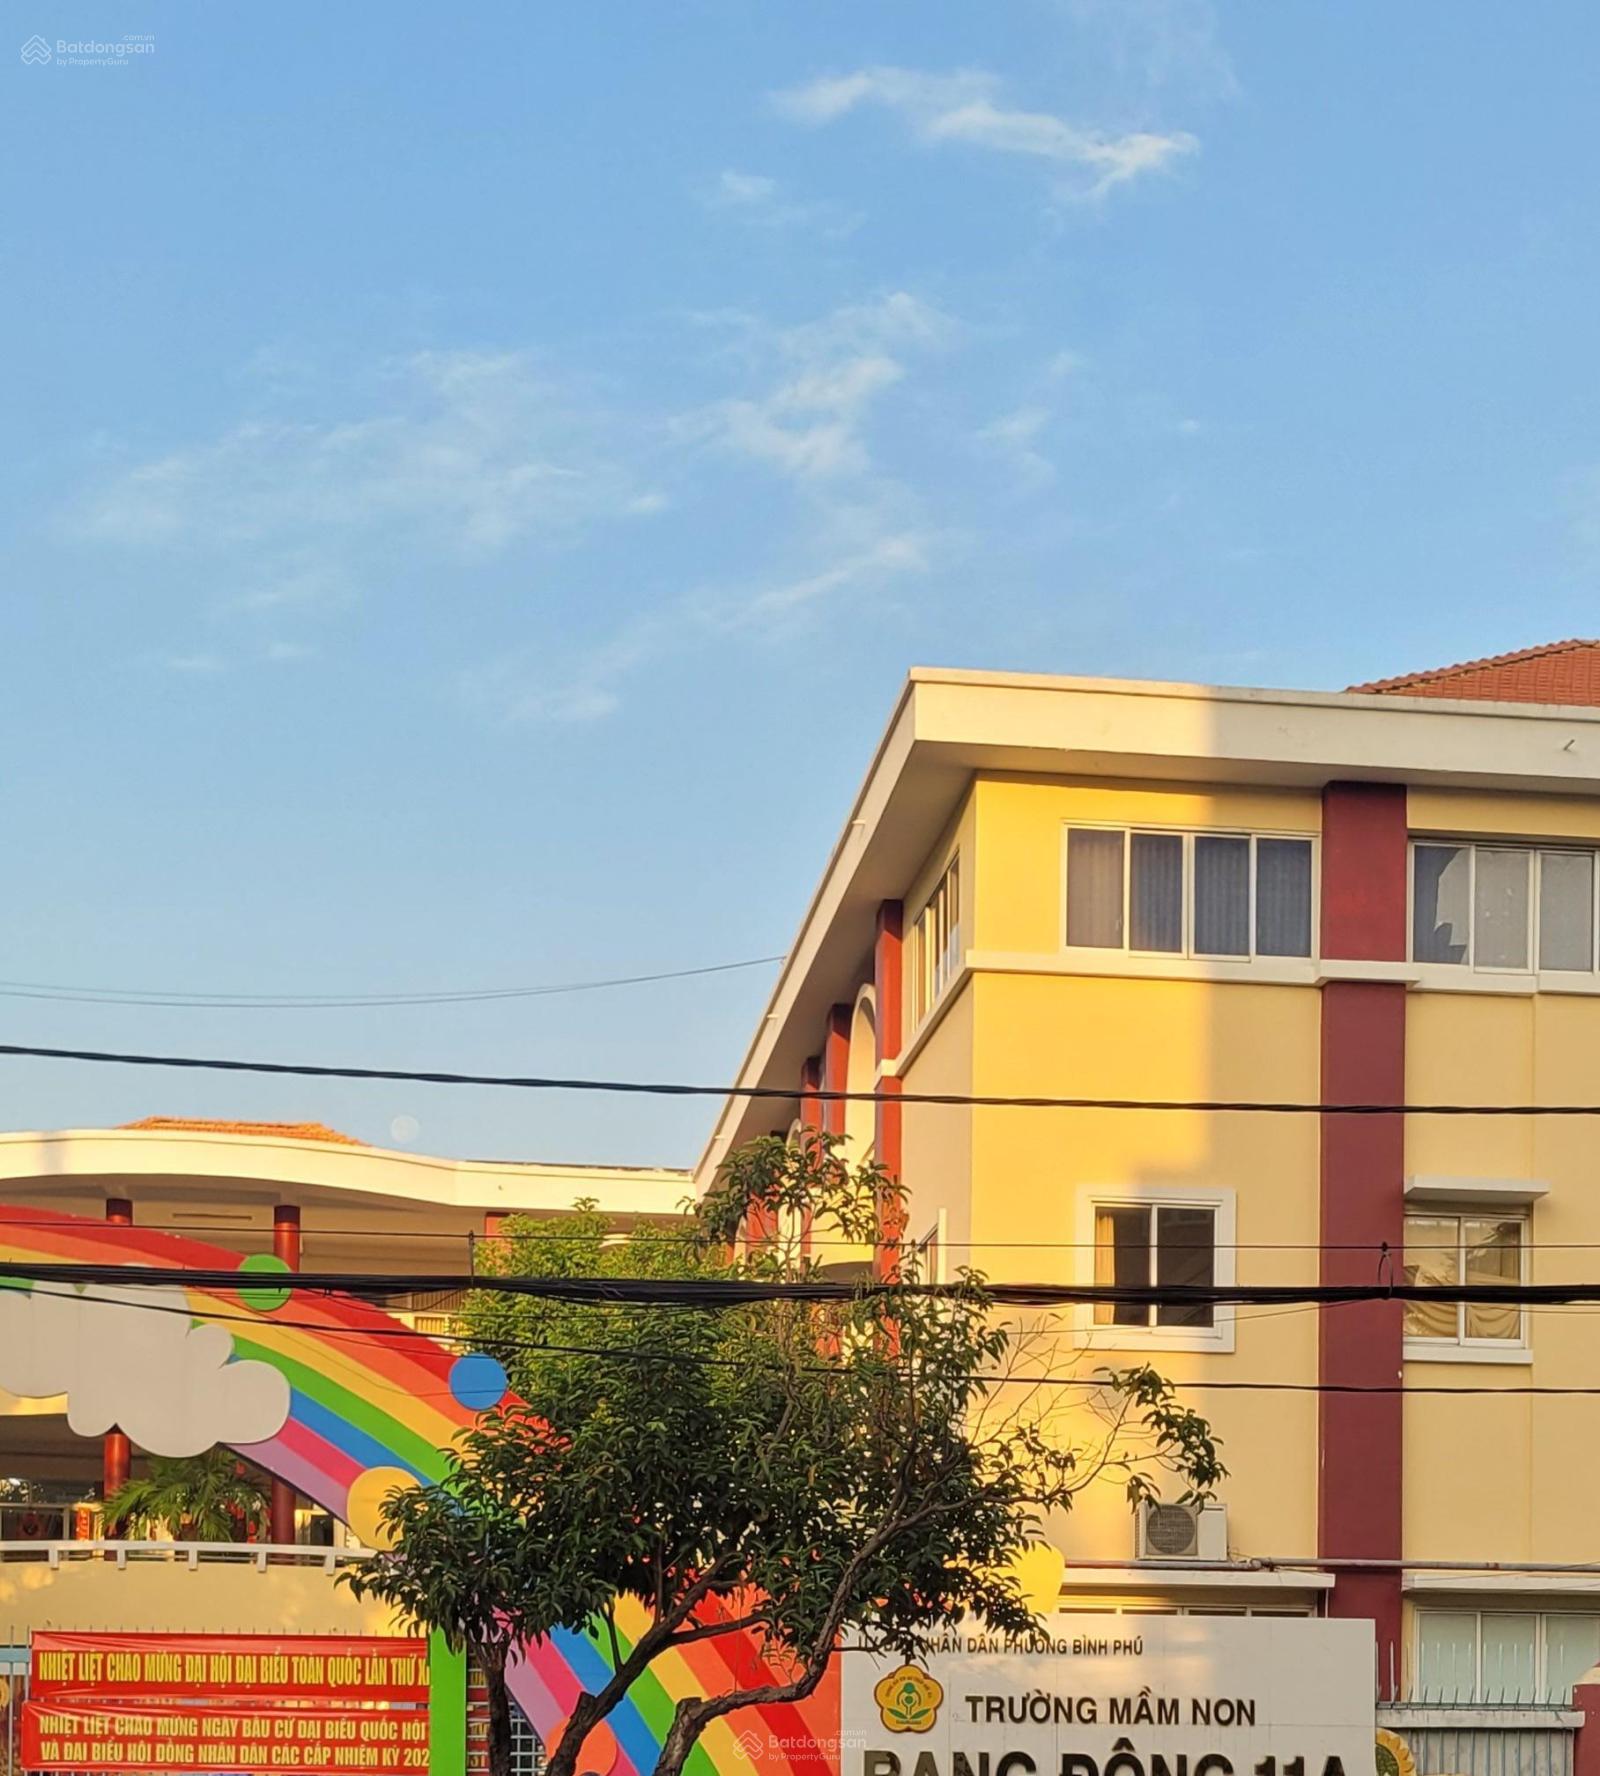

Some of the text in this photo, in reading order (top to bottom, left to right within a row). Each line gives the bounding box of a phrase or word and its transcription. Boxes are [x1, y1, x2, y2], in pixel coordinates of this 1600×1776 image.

[968, 1634, 998, 1655] DÂN
[1073, 1635, 1109, 1656] BÌNH
[1113, 1635, 1144, 1656] PHÚ
[39, 1649, 75, 1687] NHIỆT
[78, 1649, 104, 1687] LIỆT
[107, 1649, 141, 1682] CHÀO
[144, 1650, 182, 1683] MỪNG
[185, 1652, 207, 1689] ĐẠI
[210, 1650, 232, 1689] HỘI
[235, 1655, 257, 1689] ĐẠI
[260, 1646, 289, 1685] BIỂU
[292, 1651, 325, 1685] TOÀN
[327, 1647, 362, 1688] QUỐC
[365, 1648, 388, 1686] LẦN
[390, 1653, 417, 1686] THỨ
[965, 1686, 1256, 1727] TRƯỜNG MẦM NON
[39, 1713, 426, 1744] NHIỆT LIỆT CHÀO MỪNG NGÀY BẦU CỬ ĐẠI BIỂU QUỐC HỘI
[41, 1735, 430, 1770] VÀ ĐẠI BIỂU HỘI ĐỒNG NHÂN DÂN CÁC CẤP NHIỆM KỲ 202
